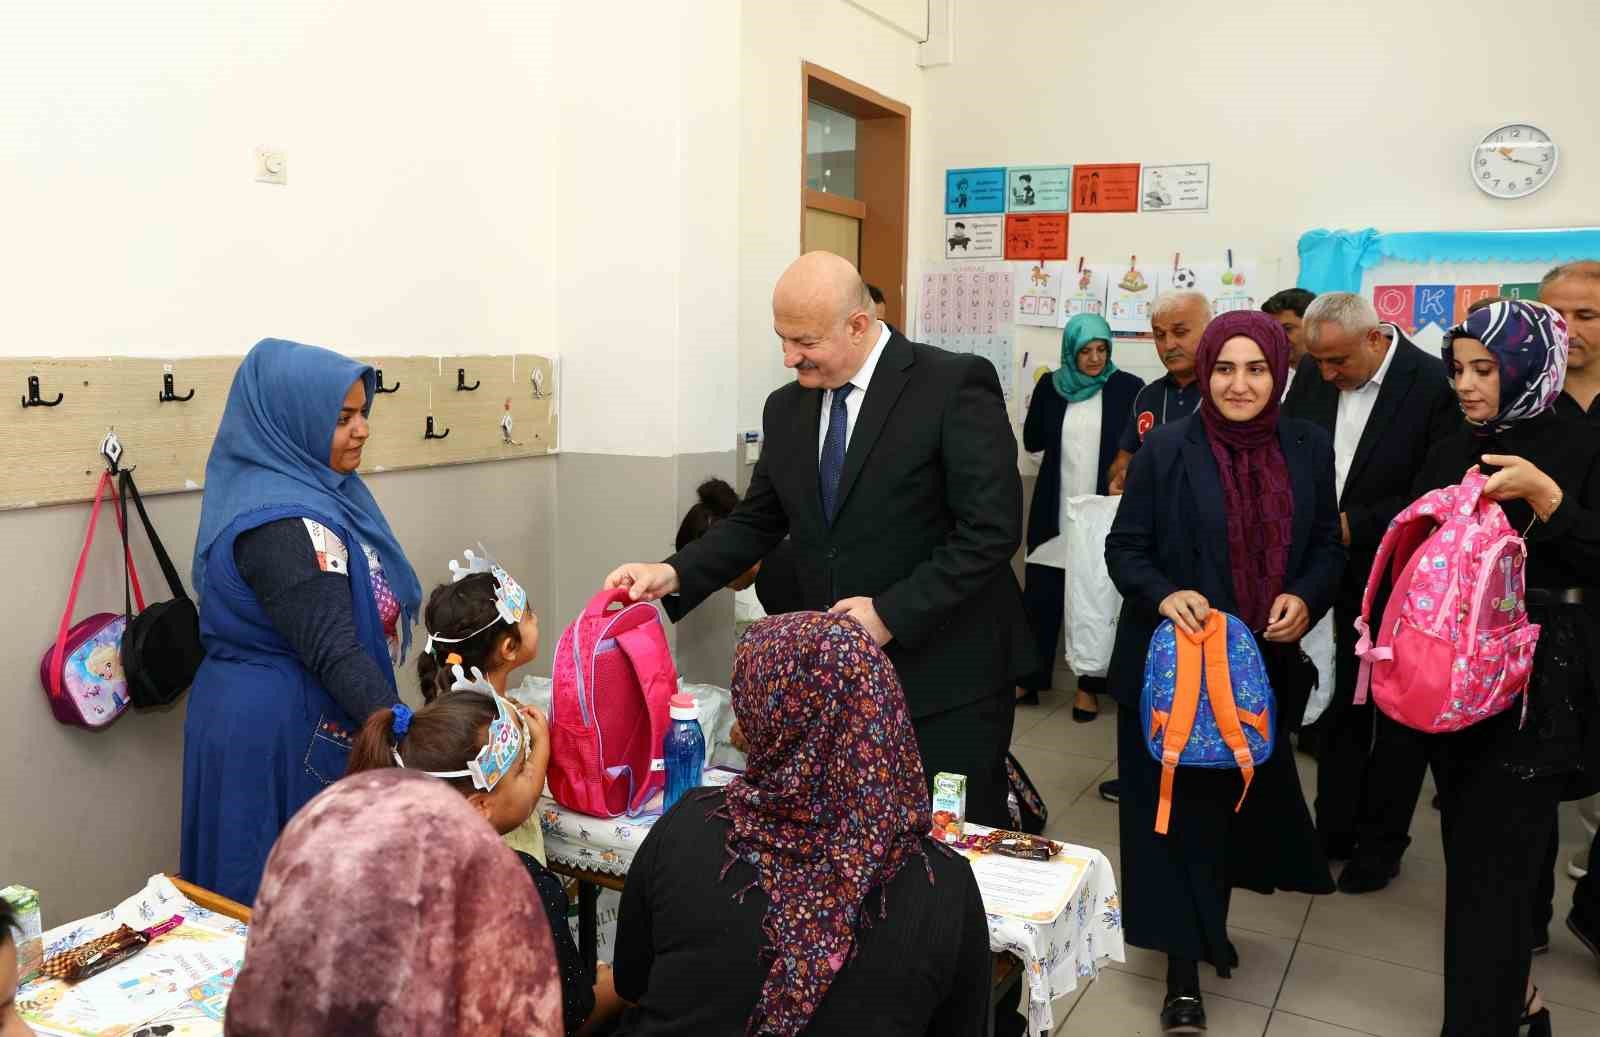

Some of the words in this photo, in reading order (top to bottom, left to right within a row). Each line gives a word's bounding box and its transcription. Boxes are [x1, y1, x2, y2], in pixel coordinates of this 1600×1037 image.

[1541, 153, 1549, 161] 3
[1479, 158, 1487, 166] 9
[1525, 177, 1533, 185] 5
